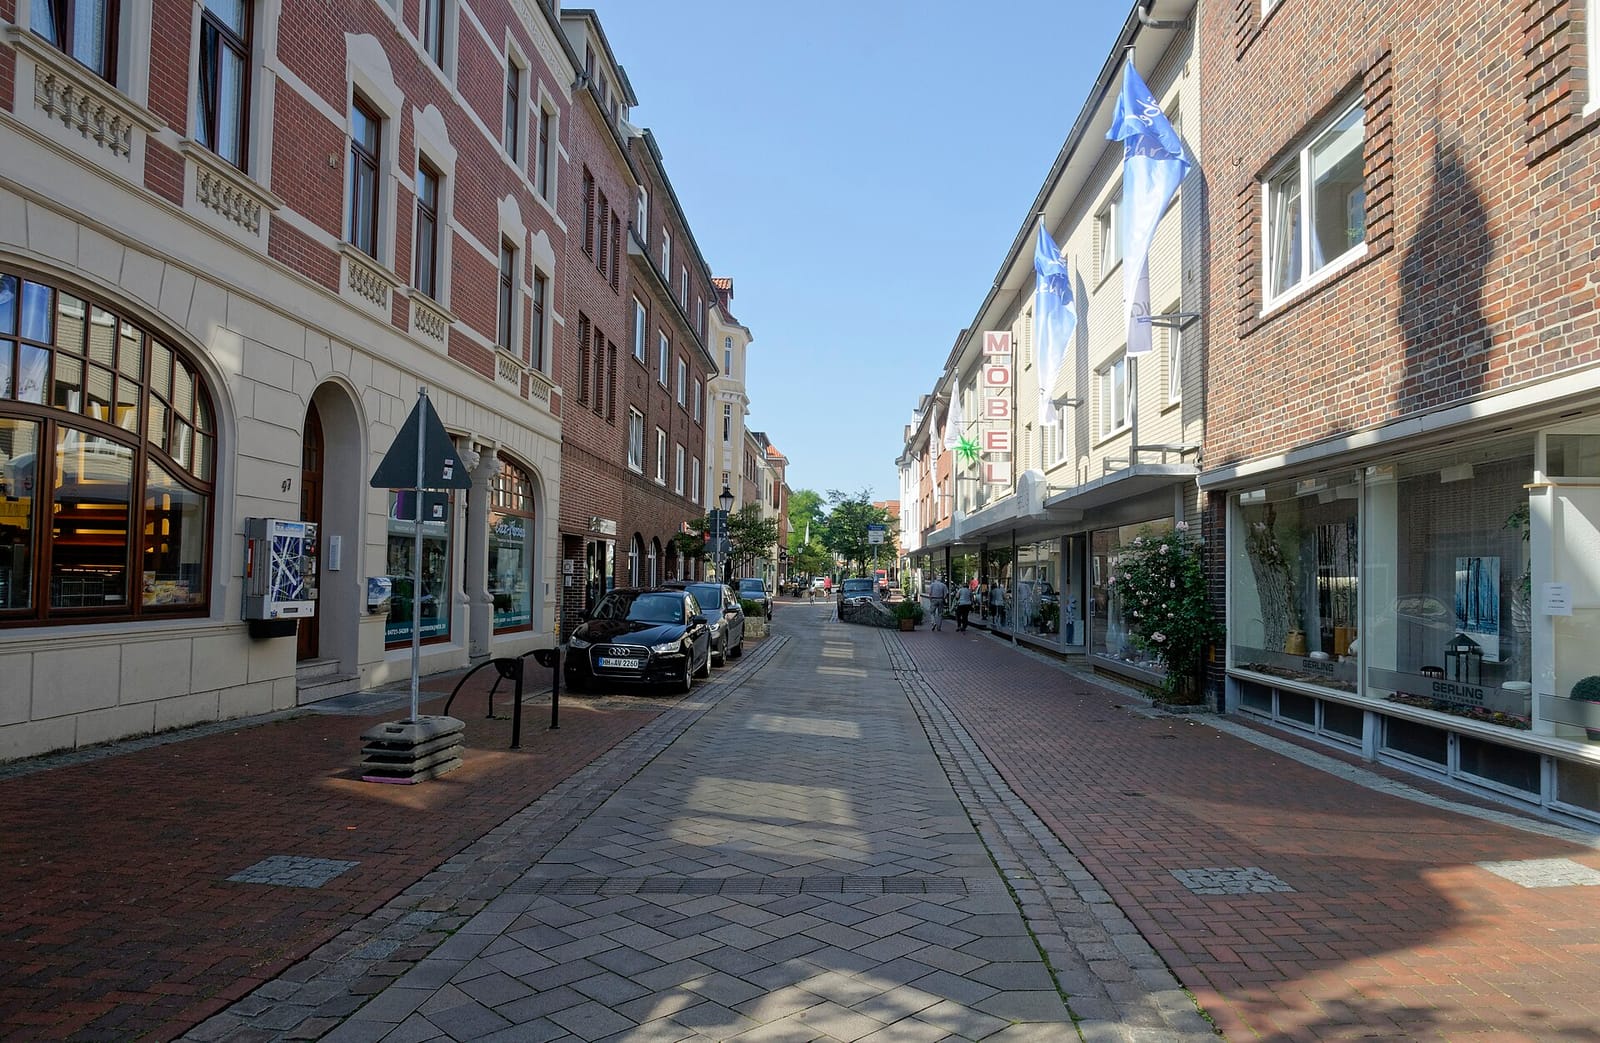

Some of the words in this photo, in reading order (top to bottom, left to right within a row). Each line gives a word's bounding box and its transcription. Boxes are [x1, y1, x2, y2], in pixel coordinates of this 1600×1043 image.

[986, 333, 1010, 483] MÖBEL
[1302, 659, 1334, 673] GERLING
[1432, 681, 1484, 700] GERLING
